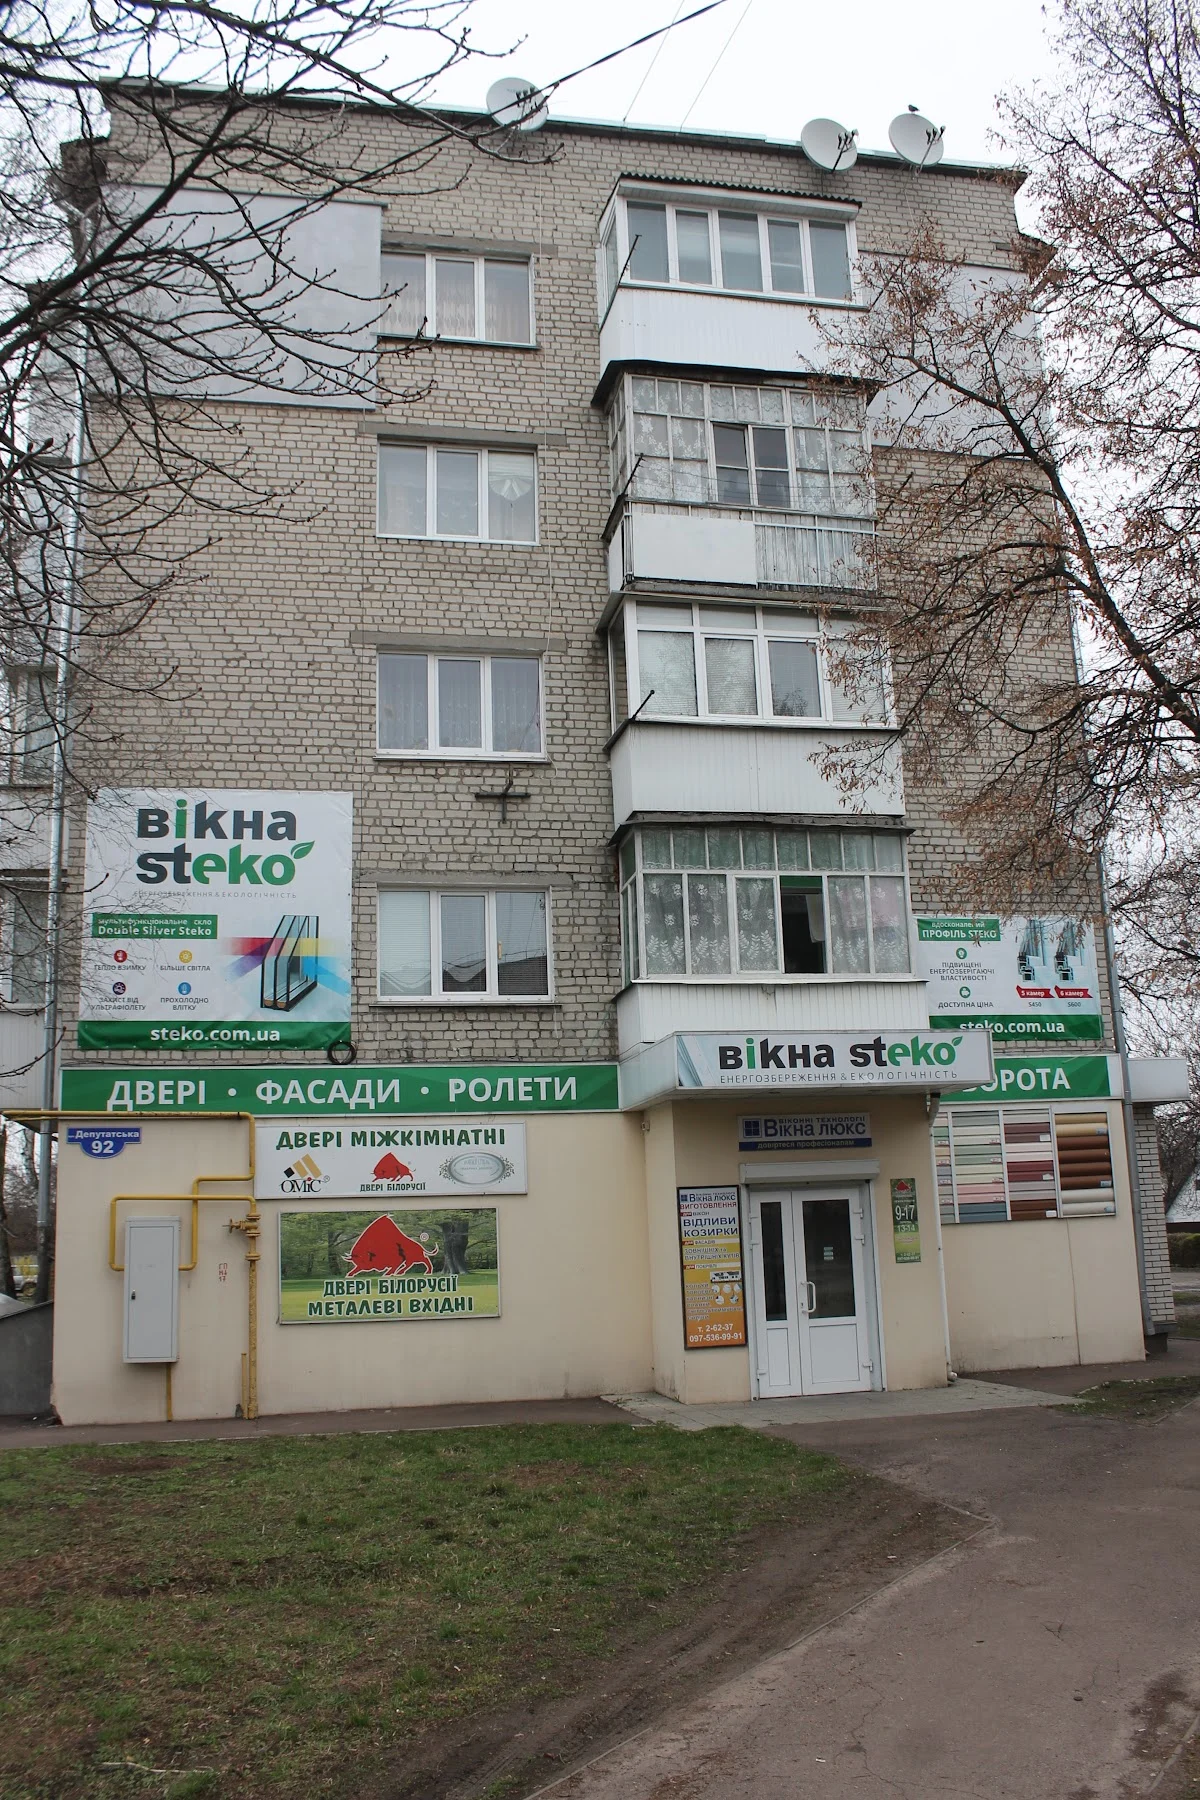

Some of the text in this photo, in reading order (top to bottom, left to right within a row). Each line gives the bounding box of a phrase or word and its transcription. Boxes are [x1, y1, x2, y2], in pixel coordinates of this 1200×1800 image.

[136, 798, 297, 841] вікна
[135, 842, 297, 886] steko
[222, 891, 297, 899] ЕКОЛОГІЧНІСТЬ
[98, 926, 212, 936] Double Silver Steko
[922, 929, 967, 938] ПРОФІЛЬ
[150, 1026, 281, 1042] steko.com.ua
[718, 1035, 957, 1070] вікна steko
[720, 1070, 958, 1084] ЕНЕРГОЗБЕРЕЖЕННЯ & ЕКОЛОГІЧНІСТЬ
[106, 1076, 577, 1112] ДВЕРІ ФАСАДИ РОЛЕТИ
[75, 1130, 140, 1140] Депутатська
[763, 1118, 814, 1138] Вікна
[276, 1128, 506, 1150] ДВЕРІ МІЖКІМНАТНІ
[757, 1140, 855, 1150] довіртеся професіоналам
[91, 1140, 114, 1154] 92
[360, 1182, 426, 1192] ДВЕРІ БІЛОРУСІЇ
[689, 1194, 712, 1202] Вікна
[895, 1204, 915, 1220] 9-17
[683, 1217, 736, 1228] ВІДЛИВИ
[684, 1228, 738, 1238] КОЗИРКИ
[323, 1275, 459, 1298] ДВЕРІ БІЛОРУСІЇ
[308, 1296, 473, 1316] МЕТАЛЕВІ ВХІДНІ
[705, 1323, 734, 1332] 2-62-37
[689, 1332, 742, 1342] 097-536-99-91
